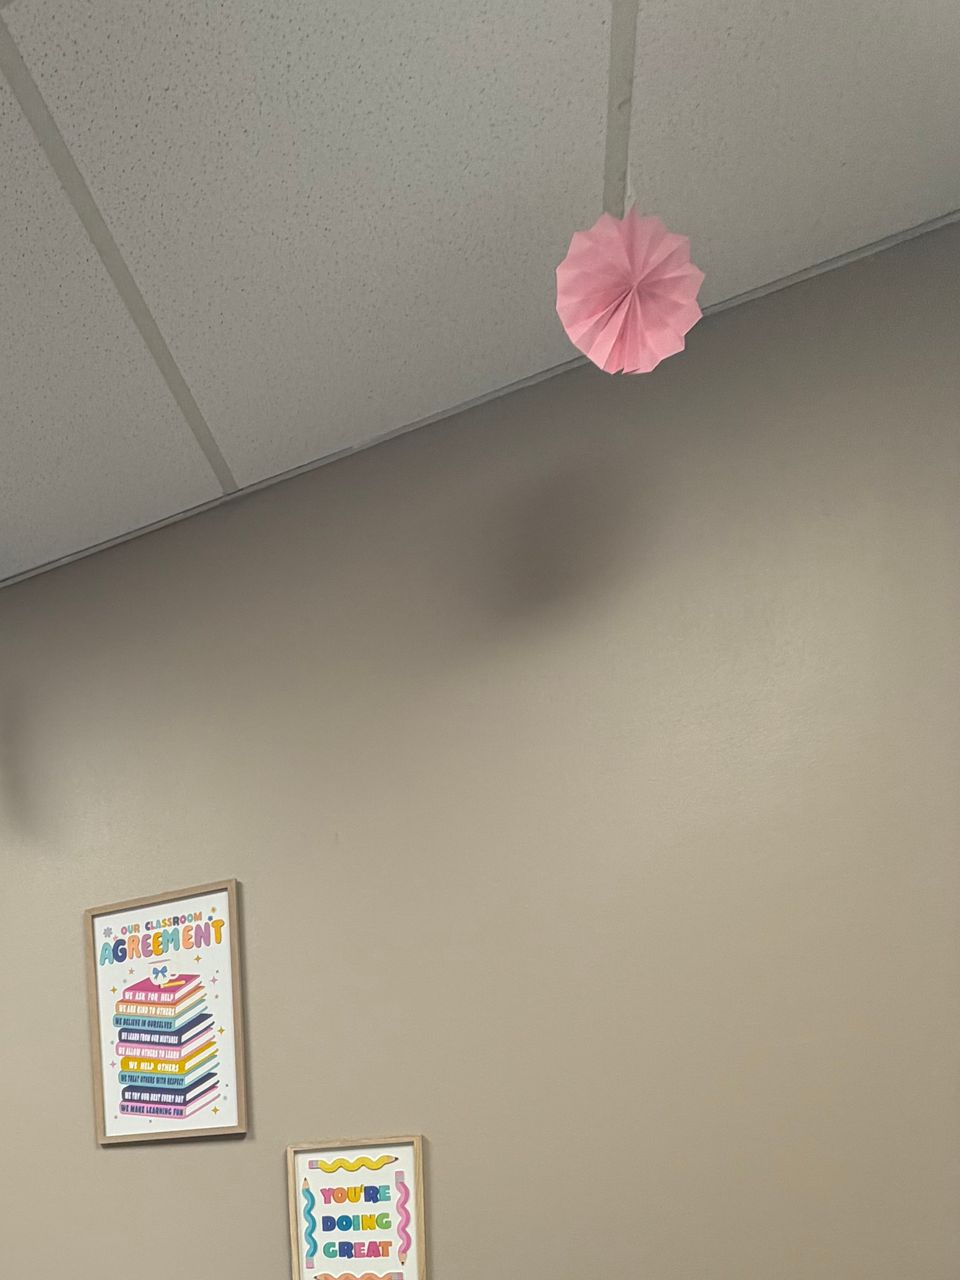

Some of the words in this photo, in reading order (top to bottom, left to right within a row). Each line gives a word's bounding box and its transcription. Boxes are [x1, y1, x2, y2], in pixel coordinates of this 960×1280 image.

[121, 923, 140, 935] OUR
[145, 911, 203, 931] CLASSROOM
[99, 918, 225, 966] AGREEMENT
[125, 992, 133, 1000] WE
[135, 992, 145, 1001] ASK
[147, 992, 158, 1001] FOR
[161, 993, 174, 1002] HELP
[129, 1061, 137, 1069] WE
[140, 1062, 154, 1071] HELP
[157, 1063, 179, 1072] OTHERS
[121, 1104, 129, 1112] WE
[130, 1105, 145, 1114] MAKE
[146, 1106, 172, 1115] LEARNING
[173, 1108, 184, 1116] FUN
[320, 1184, 391, 1204] YOU'RE
[322, 1213, 392, 1232] DOING
[323, 1241, 392, 1259] GREAT
